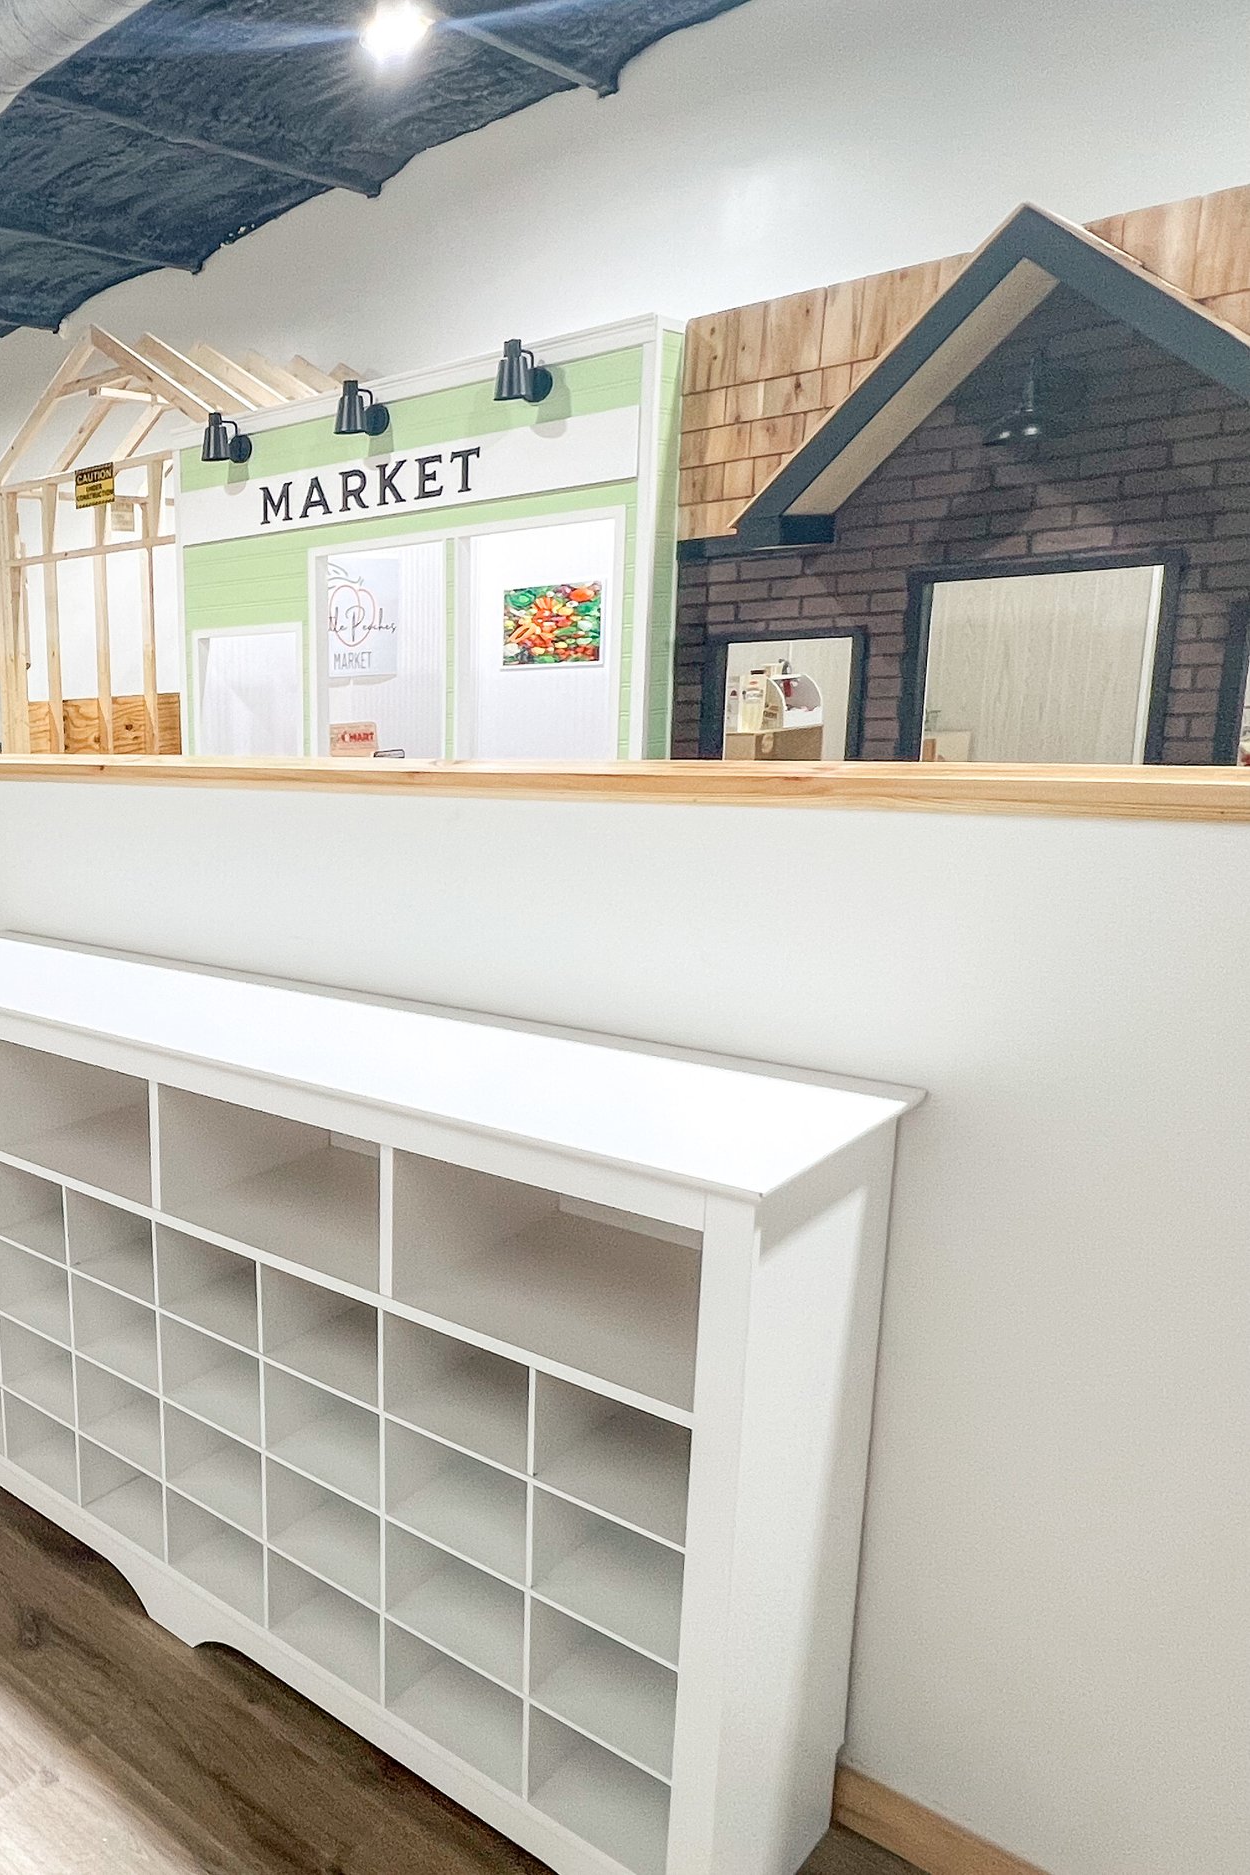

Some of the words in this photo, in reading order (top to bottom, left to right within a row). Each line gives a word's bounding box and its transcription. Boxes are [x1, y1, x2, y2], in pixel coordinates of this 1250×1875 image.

[77, 469, 111, 484] CAUTION
[259, 447, 481, 525] MARKET
[333, 651, 372, 670] MARKET
